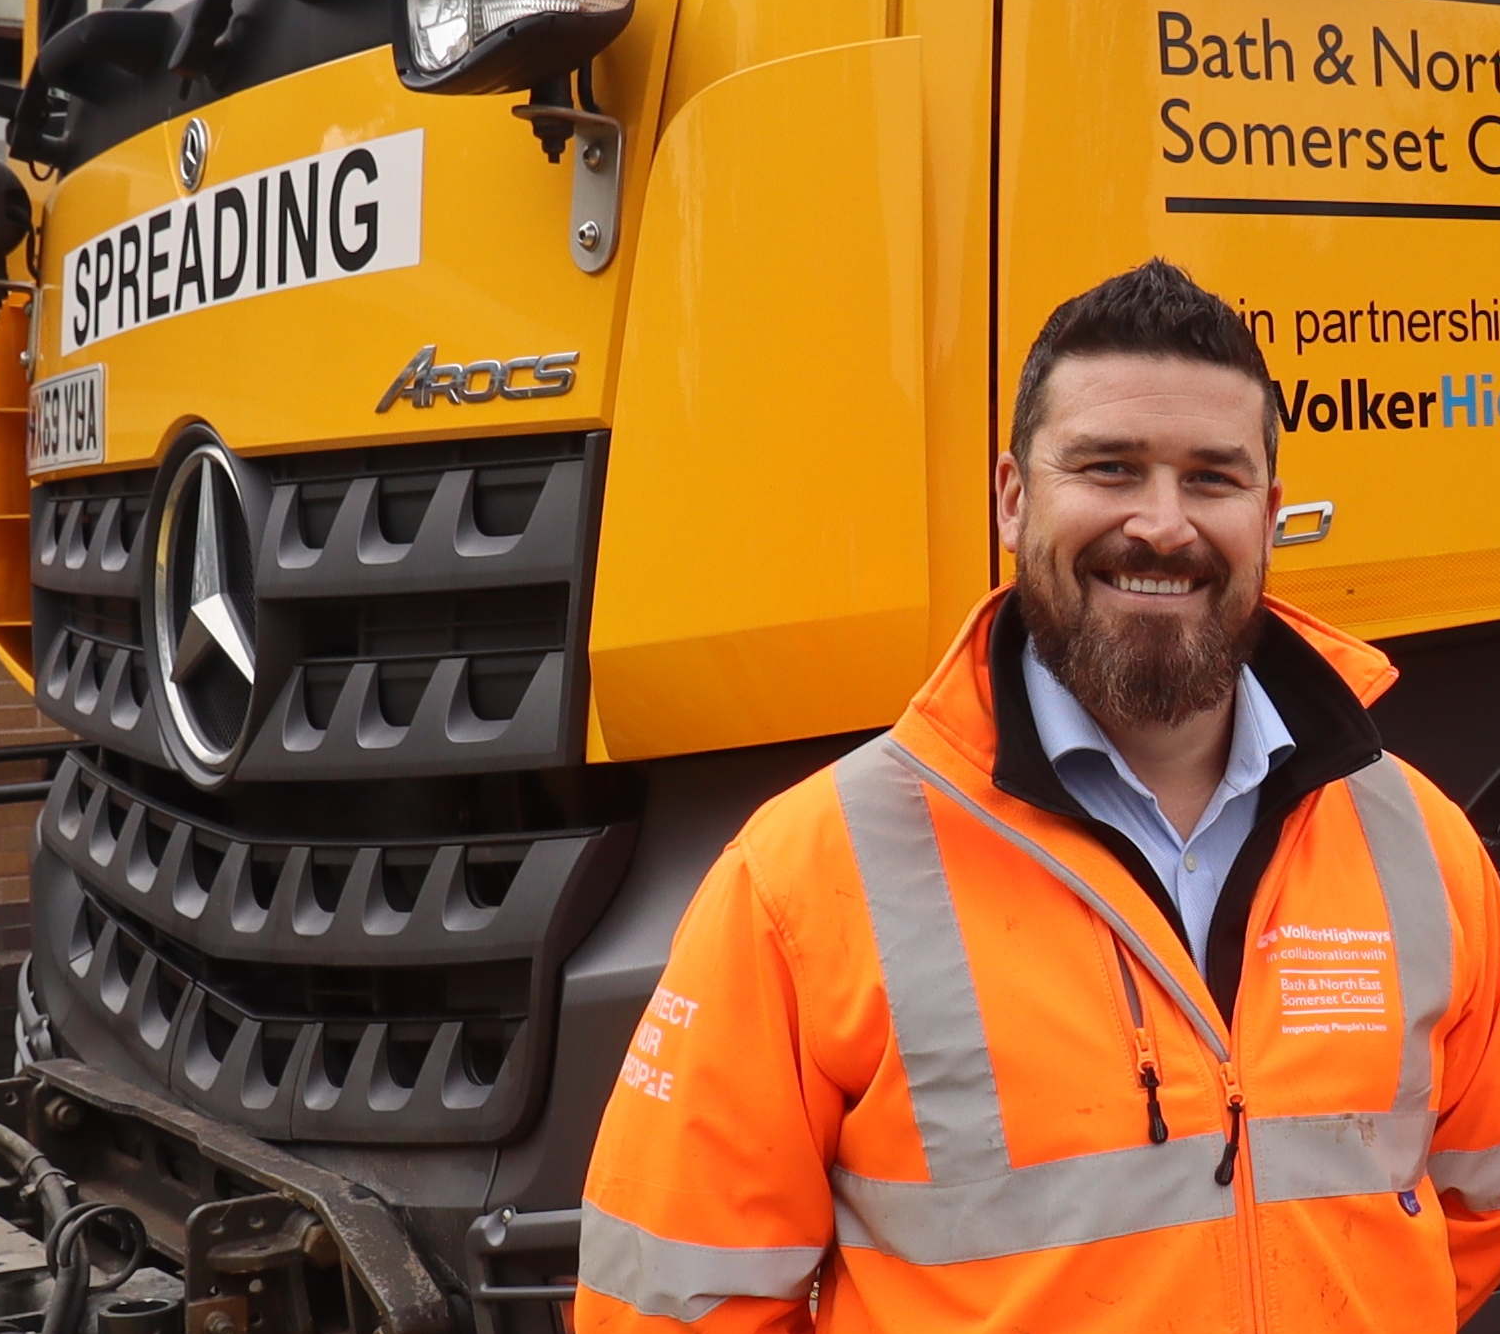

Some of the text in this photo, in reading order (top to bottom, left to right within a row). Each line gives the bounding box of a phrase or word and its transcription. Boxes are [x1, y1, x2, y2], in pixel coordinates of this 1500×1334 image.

[1157, 10, 1295, 82] Bath
[1312, 23, 1357, 86] &
[1159, 98, 1448, 173] Somerset
[73, 147, 379, 348] SPREADING
[1237, 298, 1275, 343] in
[64, 378, 98, 454] YUA
[1279, 925, 1391, 944] VolkerHighways
[1280, 946, 1359, 962] collaboration
[1360, 948, 1387, 961] with
[1280, 977, 1383, 992] Bath & North East
[1281, 992, 1385, 1007] Somerset Council
[1281, 1022, 1387, 1036] Improving People's Lives
